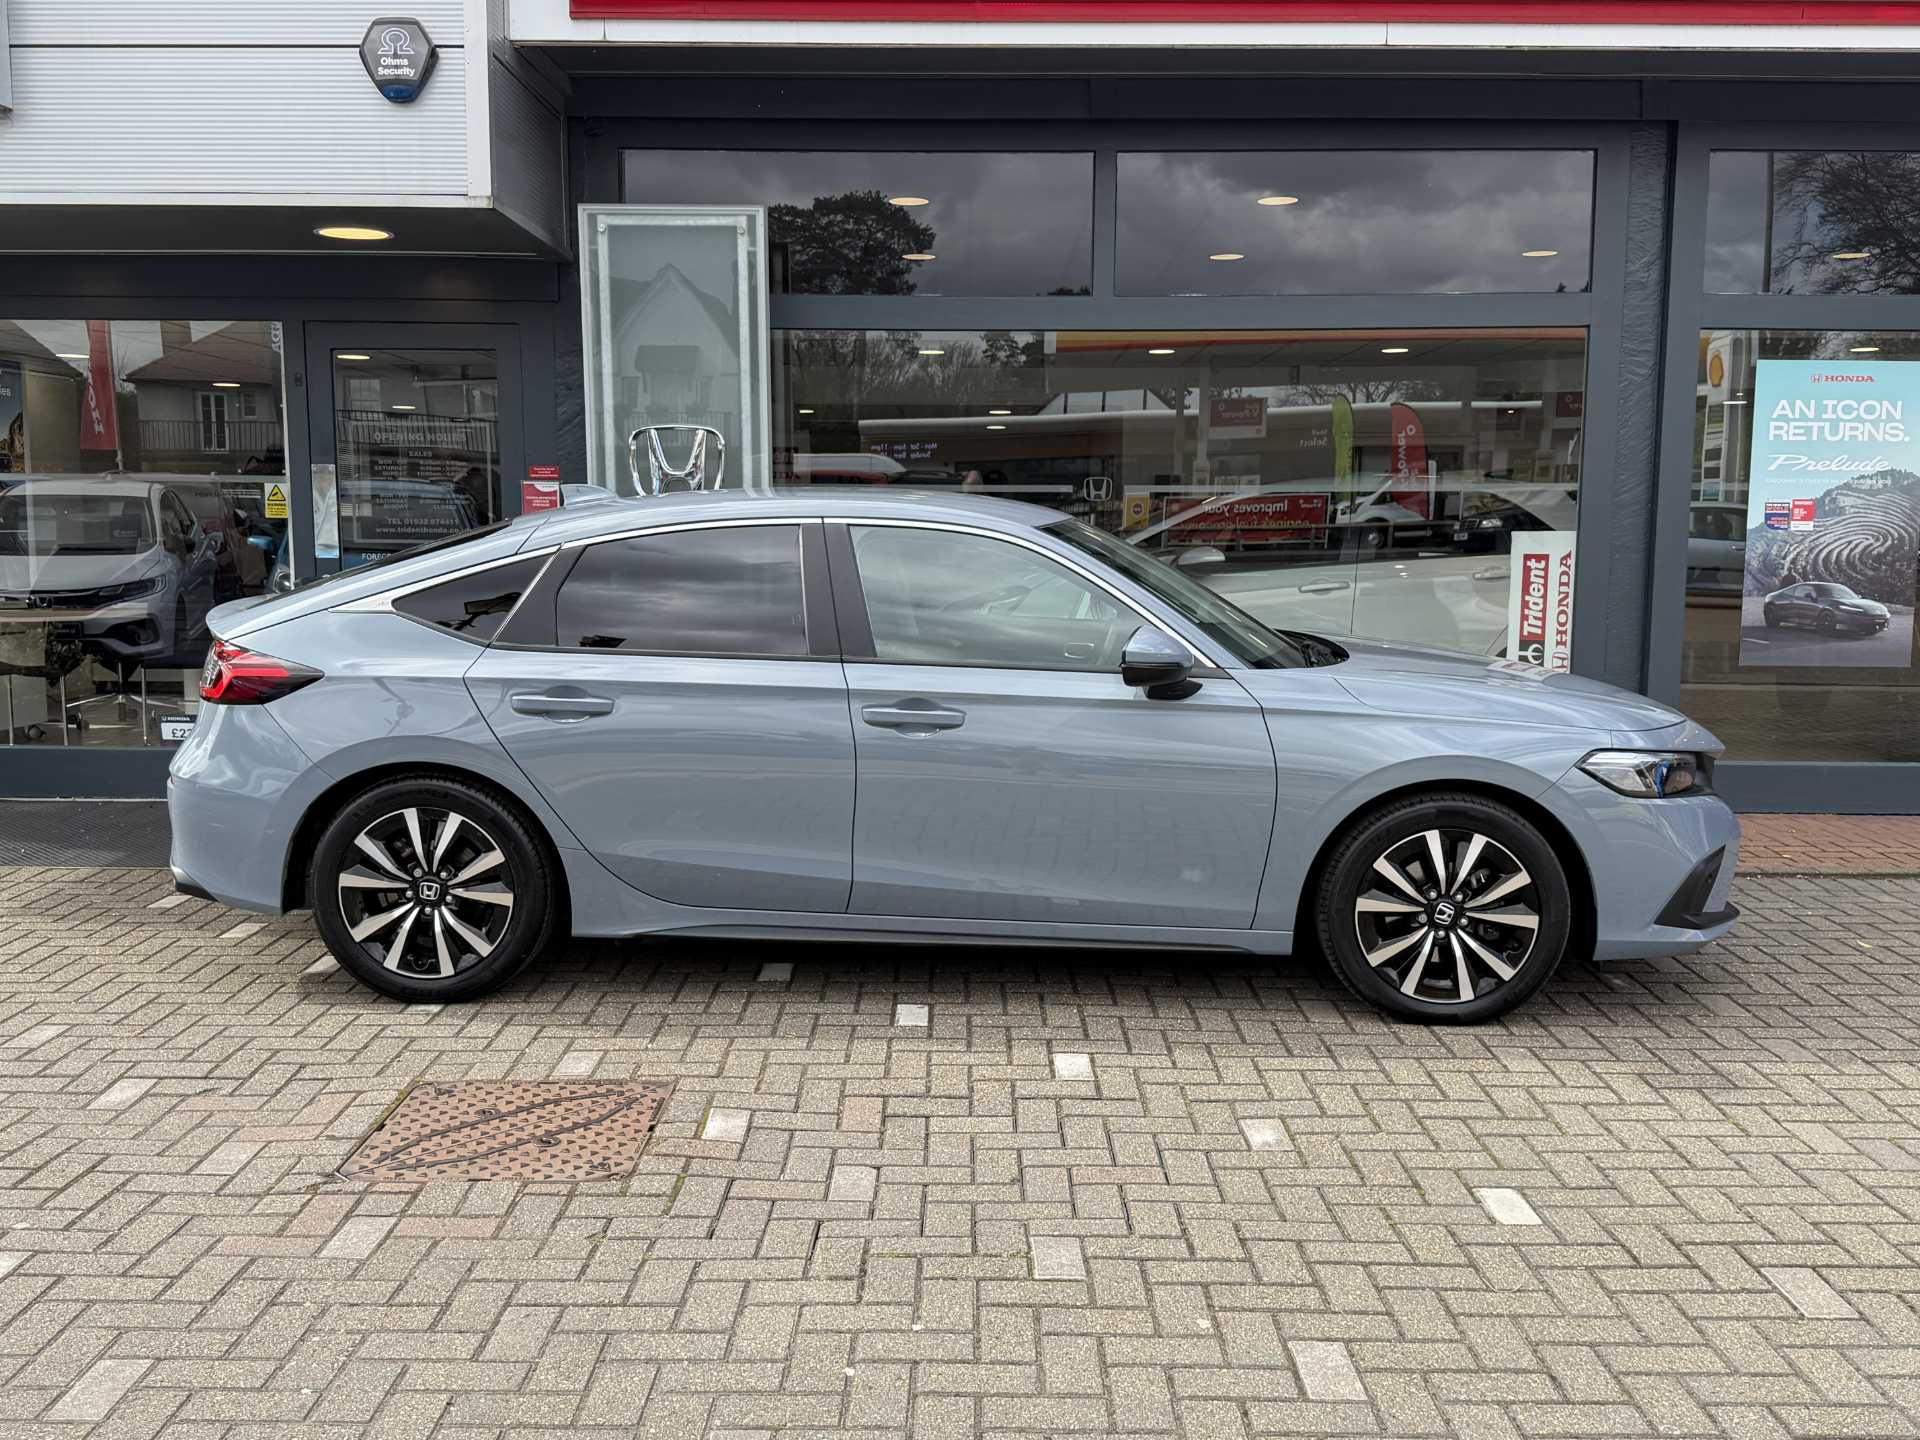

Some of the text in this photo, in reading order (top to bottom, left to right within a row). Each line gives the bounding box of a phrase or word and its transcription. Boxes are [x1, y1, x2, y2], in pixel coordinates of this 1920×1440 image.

[380, 57, 409, 66] Ohms
[377, 66, 415, 77] Security
[1824, 375, 1876, 383] HONDA
[1771, 399, 1903, 420] AN ICON
[374, 432, 466, 441] OPENING HOURS
[1768, 421, 1911, 442] RETURNS.
[1767, 454, 1890, 471] Prelude
[1523, 558, 1546, 637] Trident
[1556, 550, 1572, 648] HONDA
